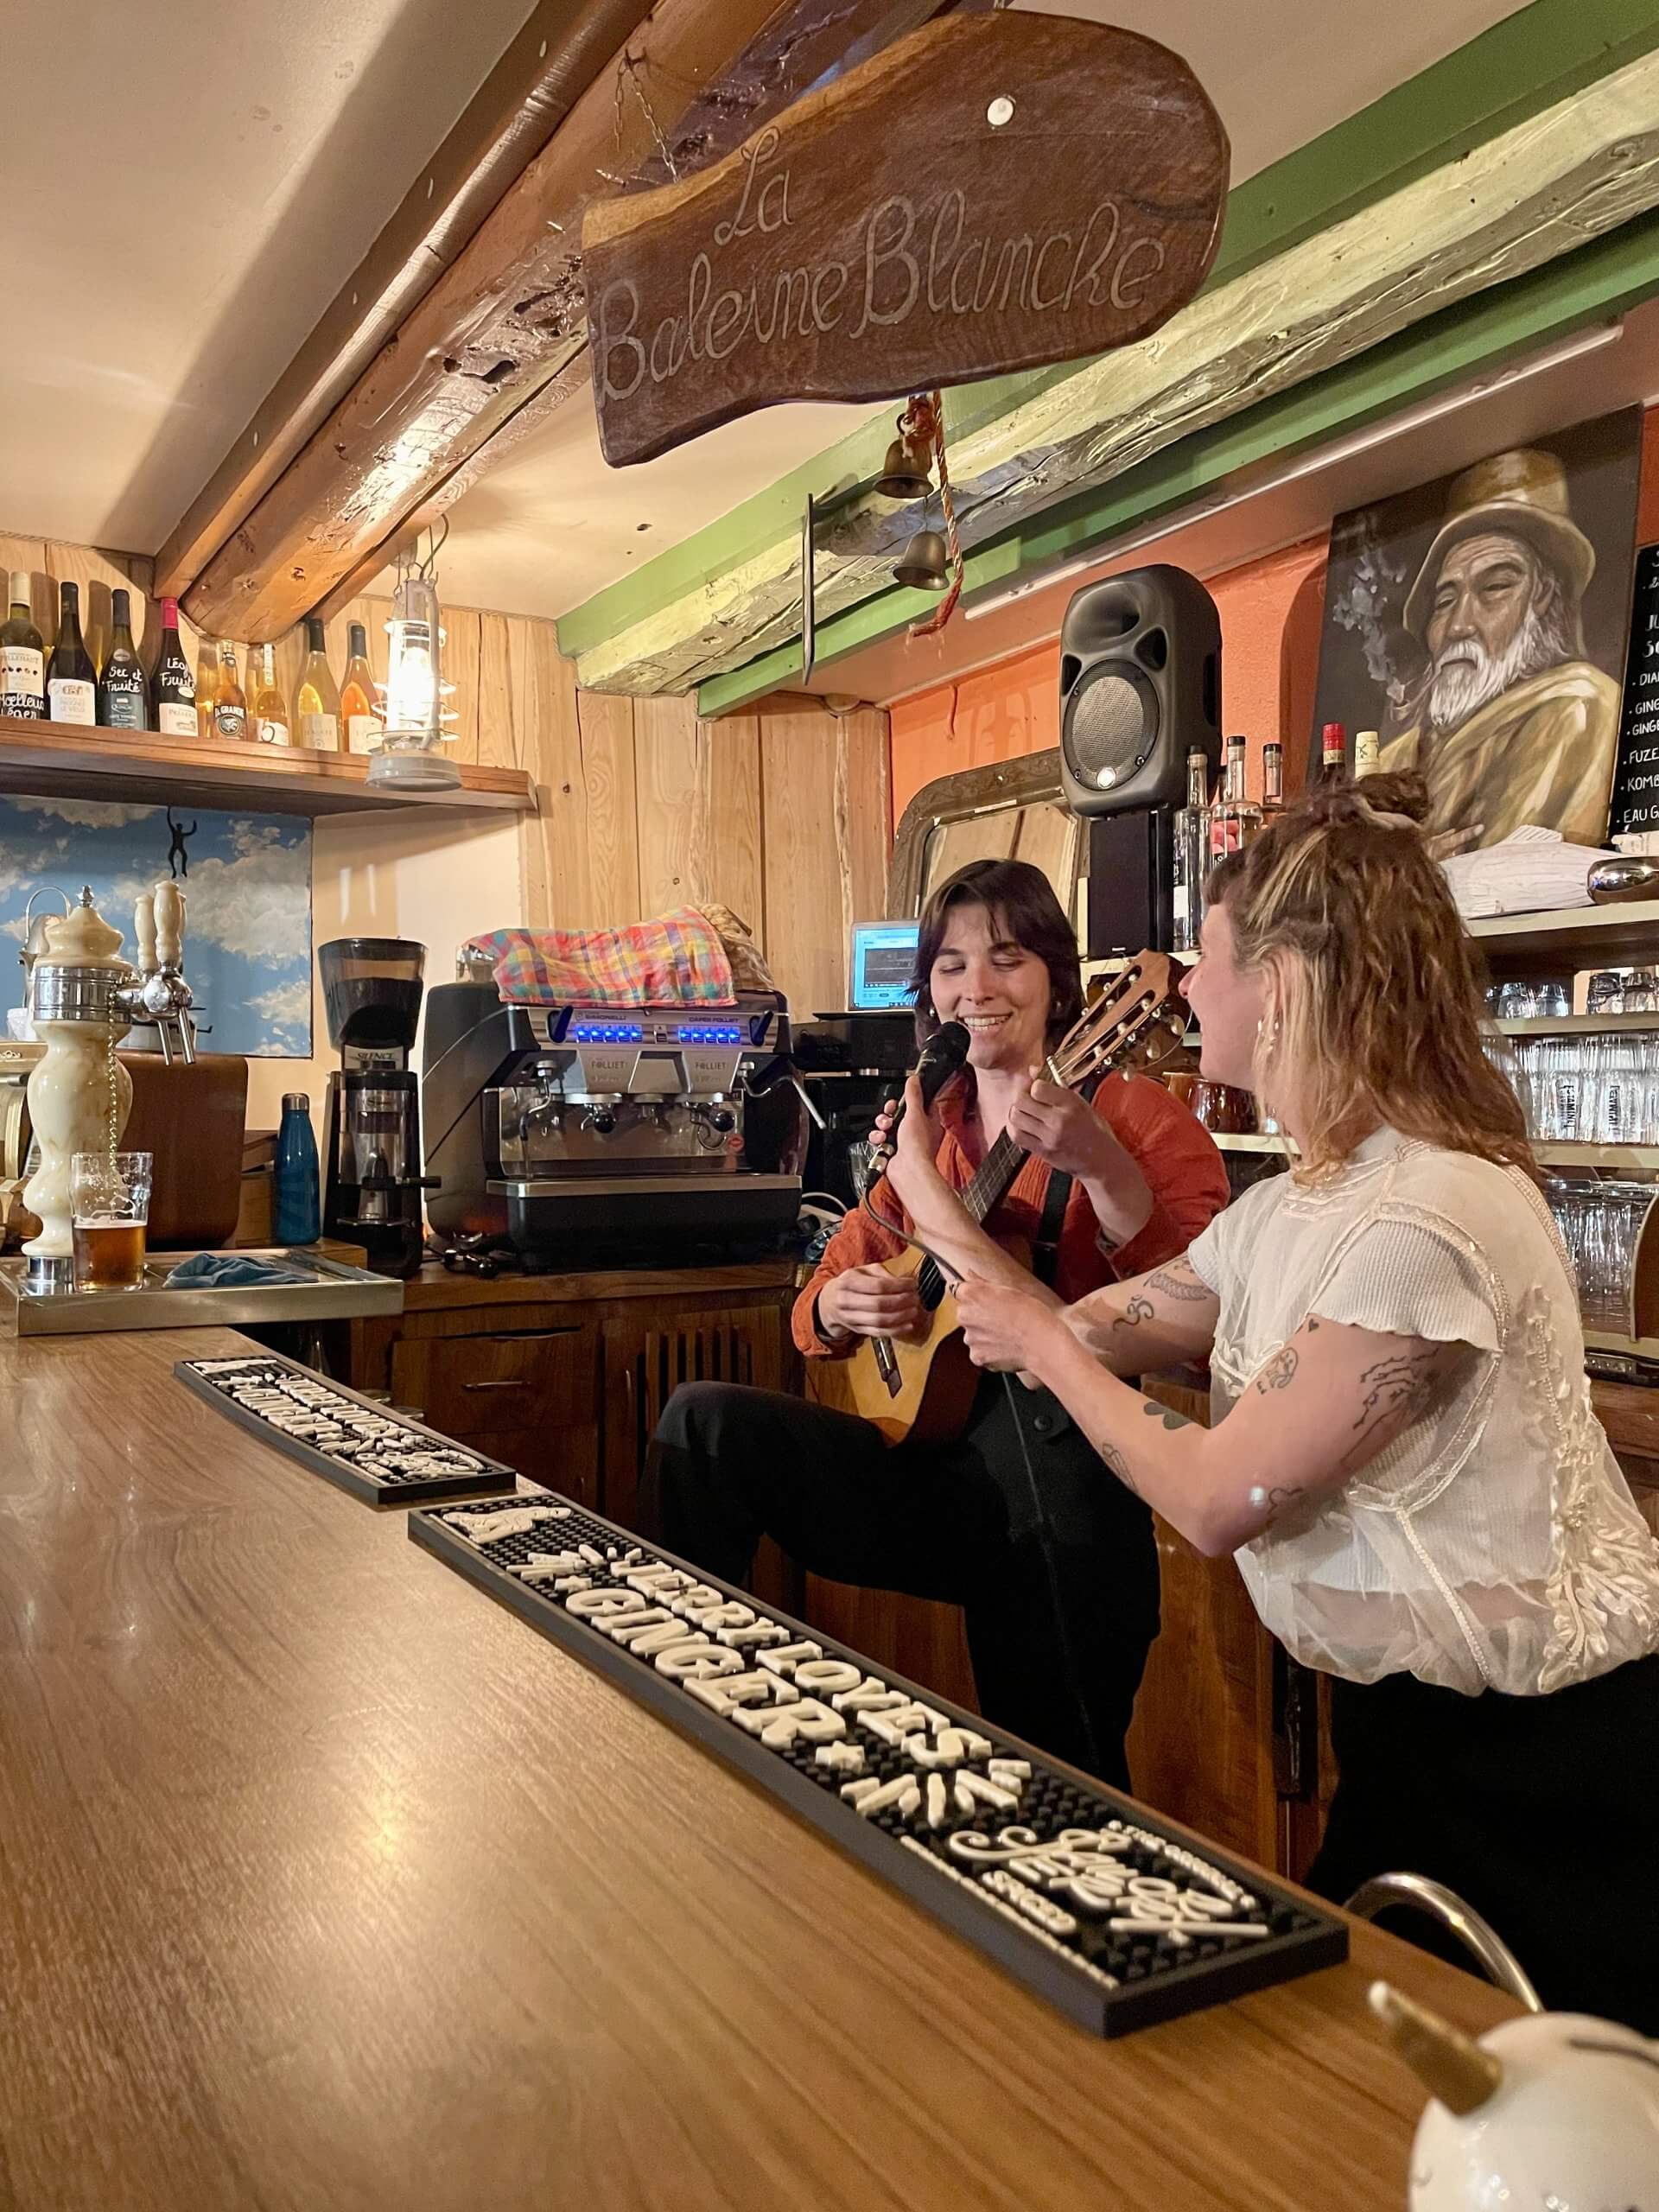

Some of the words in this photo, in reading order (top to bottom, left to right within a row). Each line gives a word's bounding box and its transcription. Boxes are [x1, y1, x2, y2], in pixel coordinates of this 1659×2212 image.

[714, 126, 796, 246] La
[597, 252, 849, 402] Baleine
[849, 188, 1165, 339] Blanche
[109, 666, 129, 677] Sec
[132, 669, 143, 682] et
[1624, 808, 1647, 823] EAU
[1629, 747, 1659, 765] FUZE
[565, 1587, 848, 1751] GINGER
[610, 1560, 791, 1647] JERRY
[755, 1640, 993, 1769] LOVES
